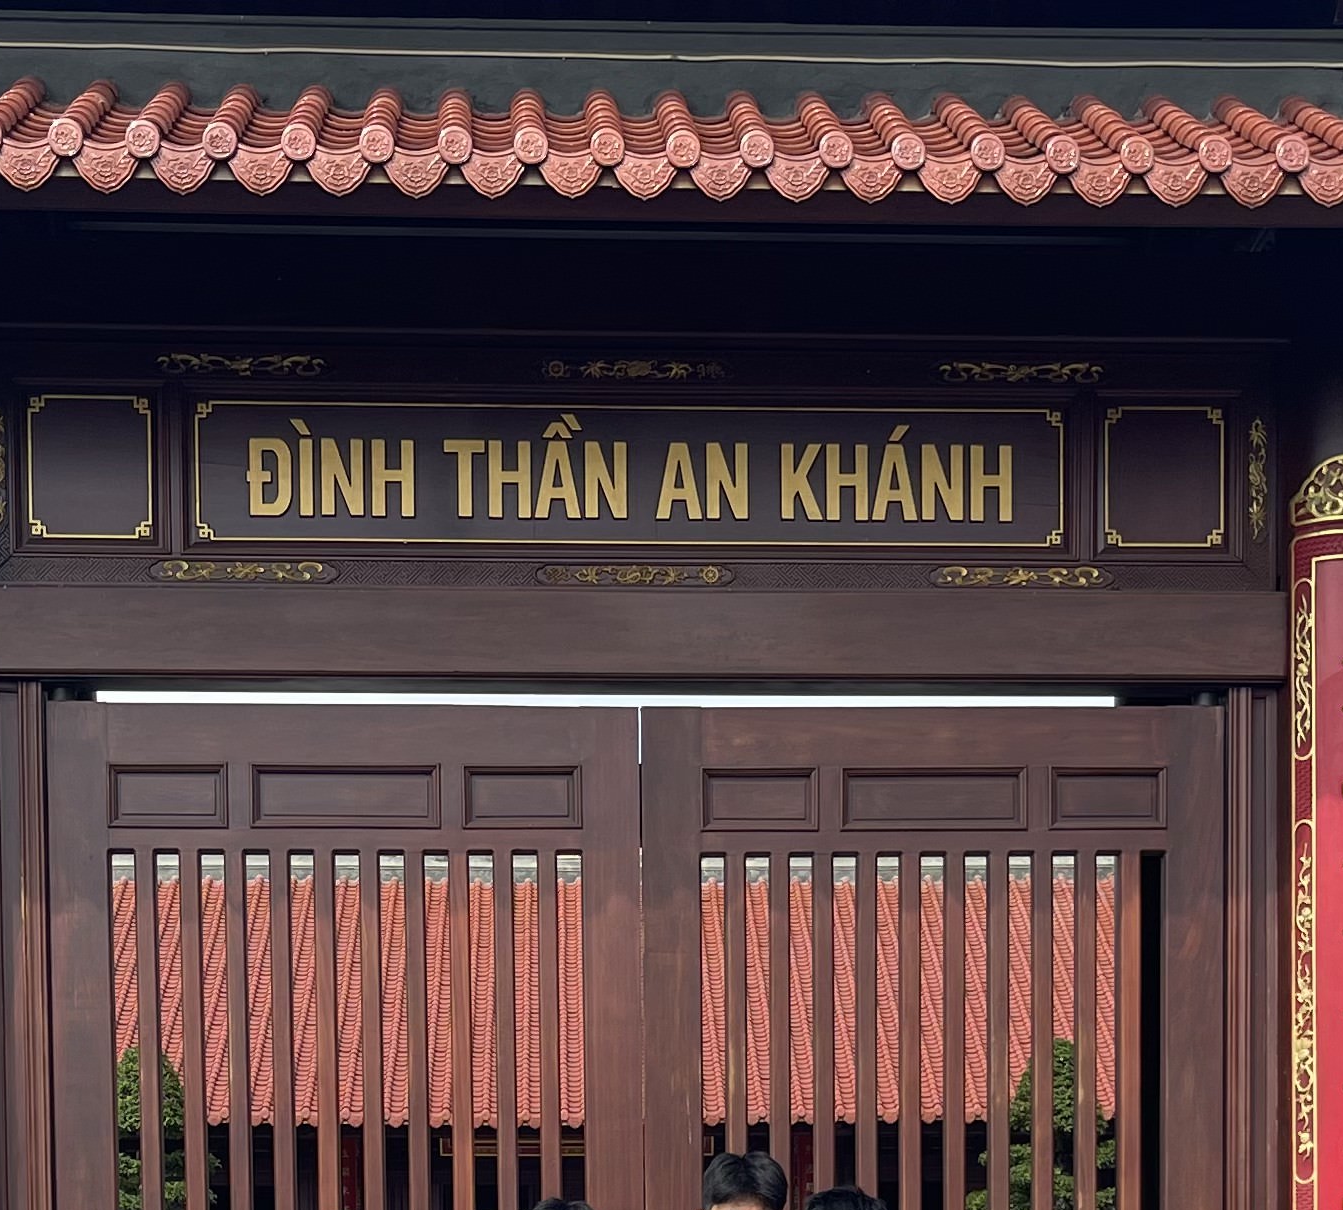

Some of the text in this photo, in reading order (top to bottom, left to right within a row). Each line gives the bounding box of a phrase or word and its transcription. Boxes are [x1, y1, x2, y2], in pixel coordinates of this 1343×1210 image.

[246, 413, 1013, 522] ĐÌNH THẦN AN KHÁNH
